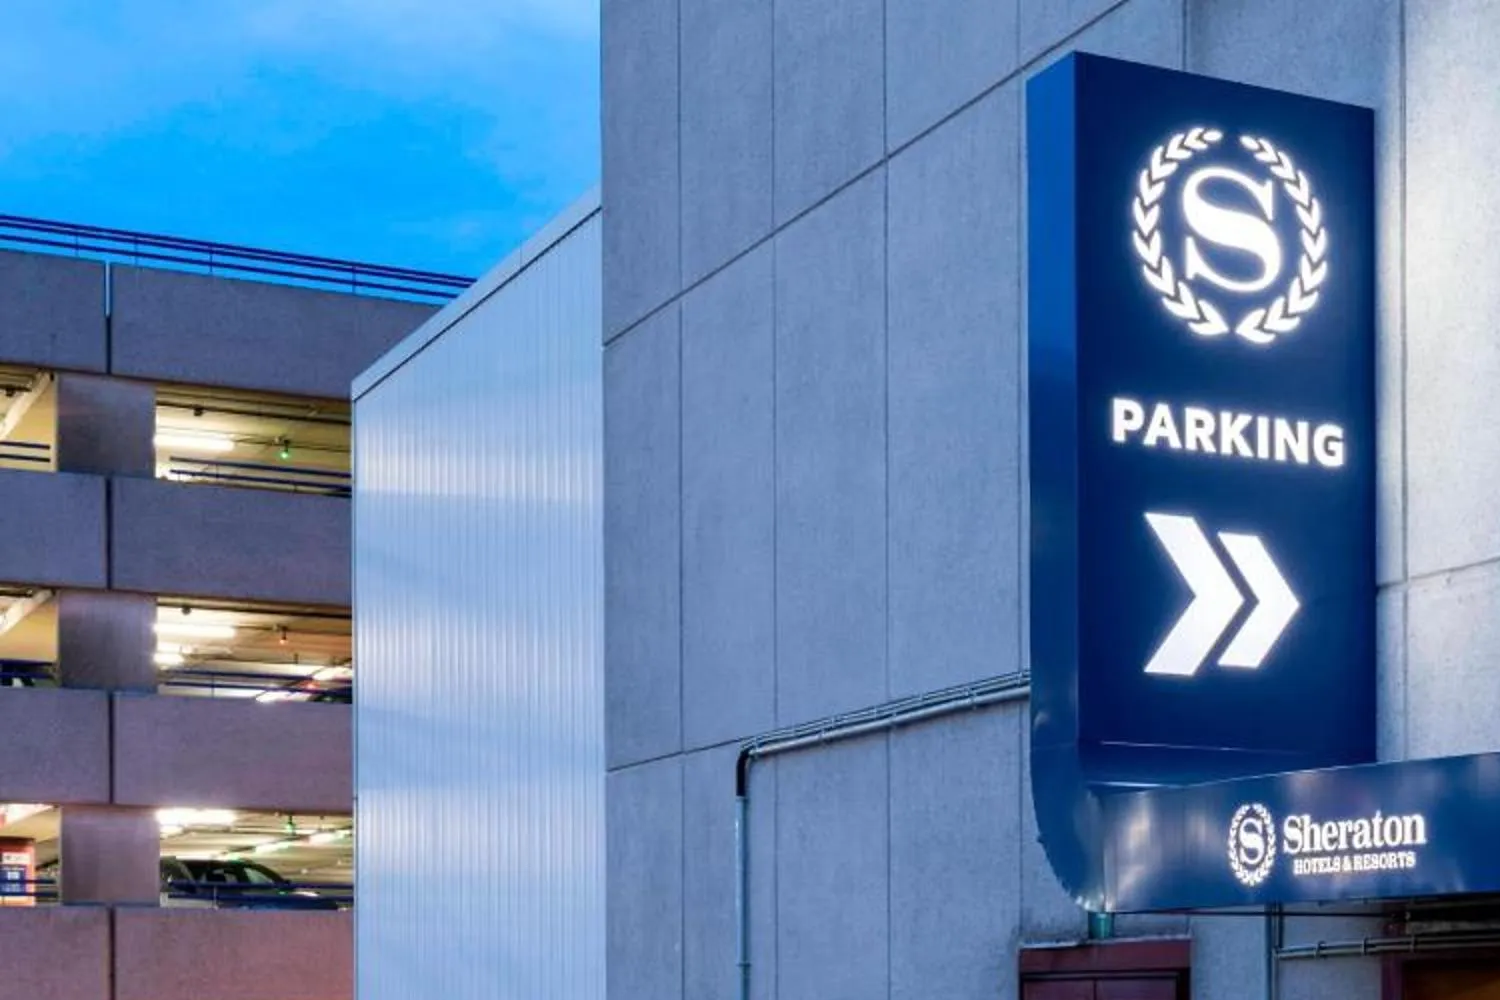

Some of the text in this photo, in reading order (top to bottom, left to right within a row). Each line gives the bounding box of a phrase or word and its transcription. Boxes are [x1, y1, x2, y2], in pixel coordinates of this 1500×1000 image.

[1183, 167, 1282, 293] S
[1112, 397, 1346, 468] PARKING
[1283, 810, 1427, 854] Sheraton
[1293, 856, 1340, 876] HOTELS
[1353, 851, 1417, 871] RESORTS
